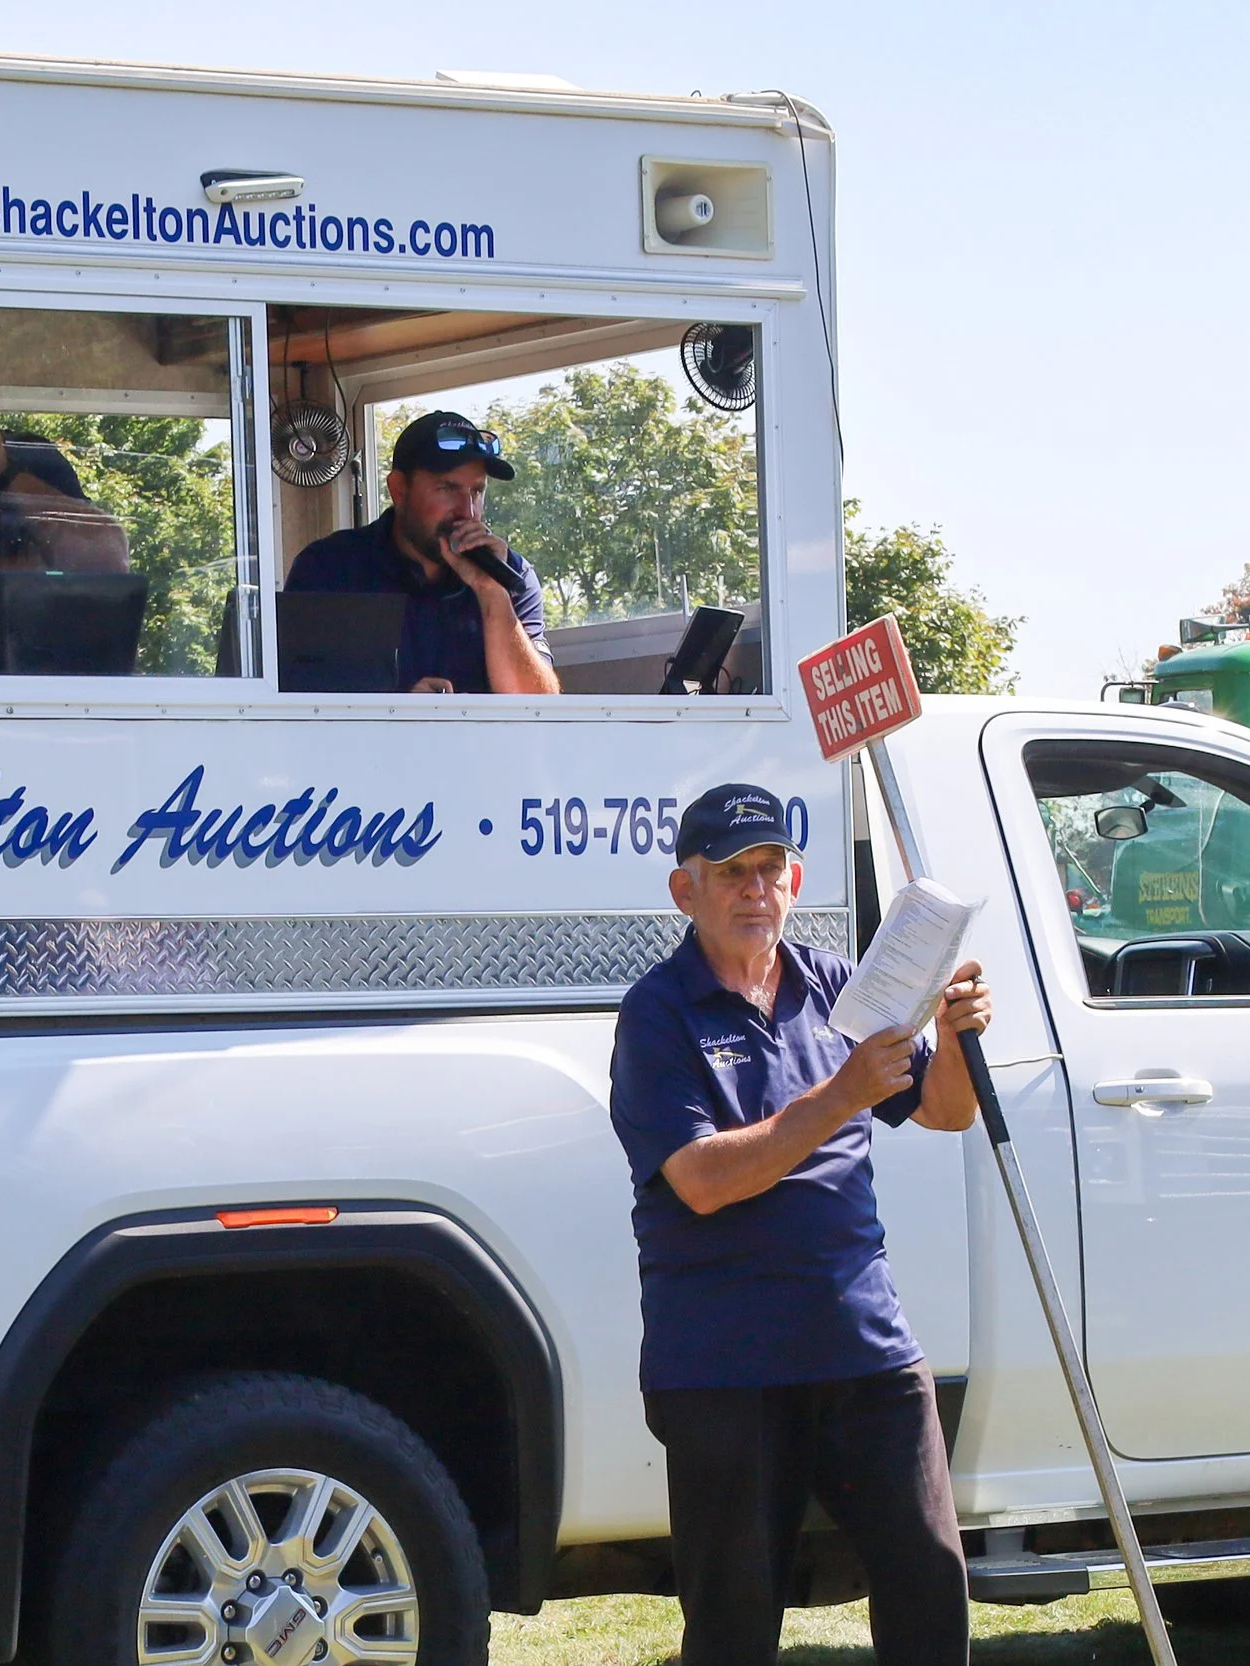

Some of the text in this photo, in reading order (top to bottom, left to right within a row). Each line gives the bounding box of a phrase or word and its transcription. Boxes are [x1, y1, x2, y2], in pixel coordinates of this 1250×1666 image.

[811, 638, 883, 701] SELLING
[817, 677, 903, 747] THIS ITEM
[110, 764, 444, 876] Auctions
[520, 796, 809, 856] 519-7650
[730, 814, 775, 828] Auctions
[699, 1033, 746, 1049] Shackelton
[711, 1054, 752, 1069] Auctions
[265, 1607, 307, 1658] GMC
